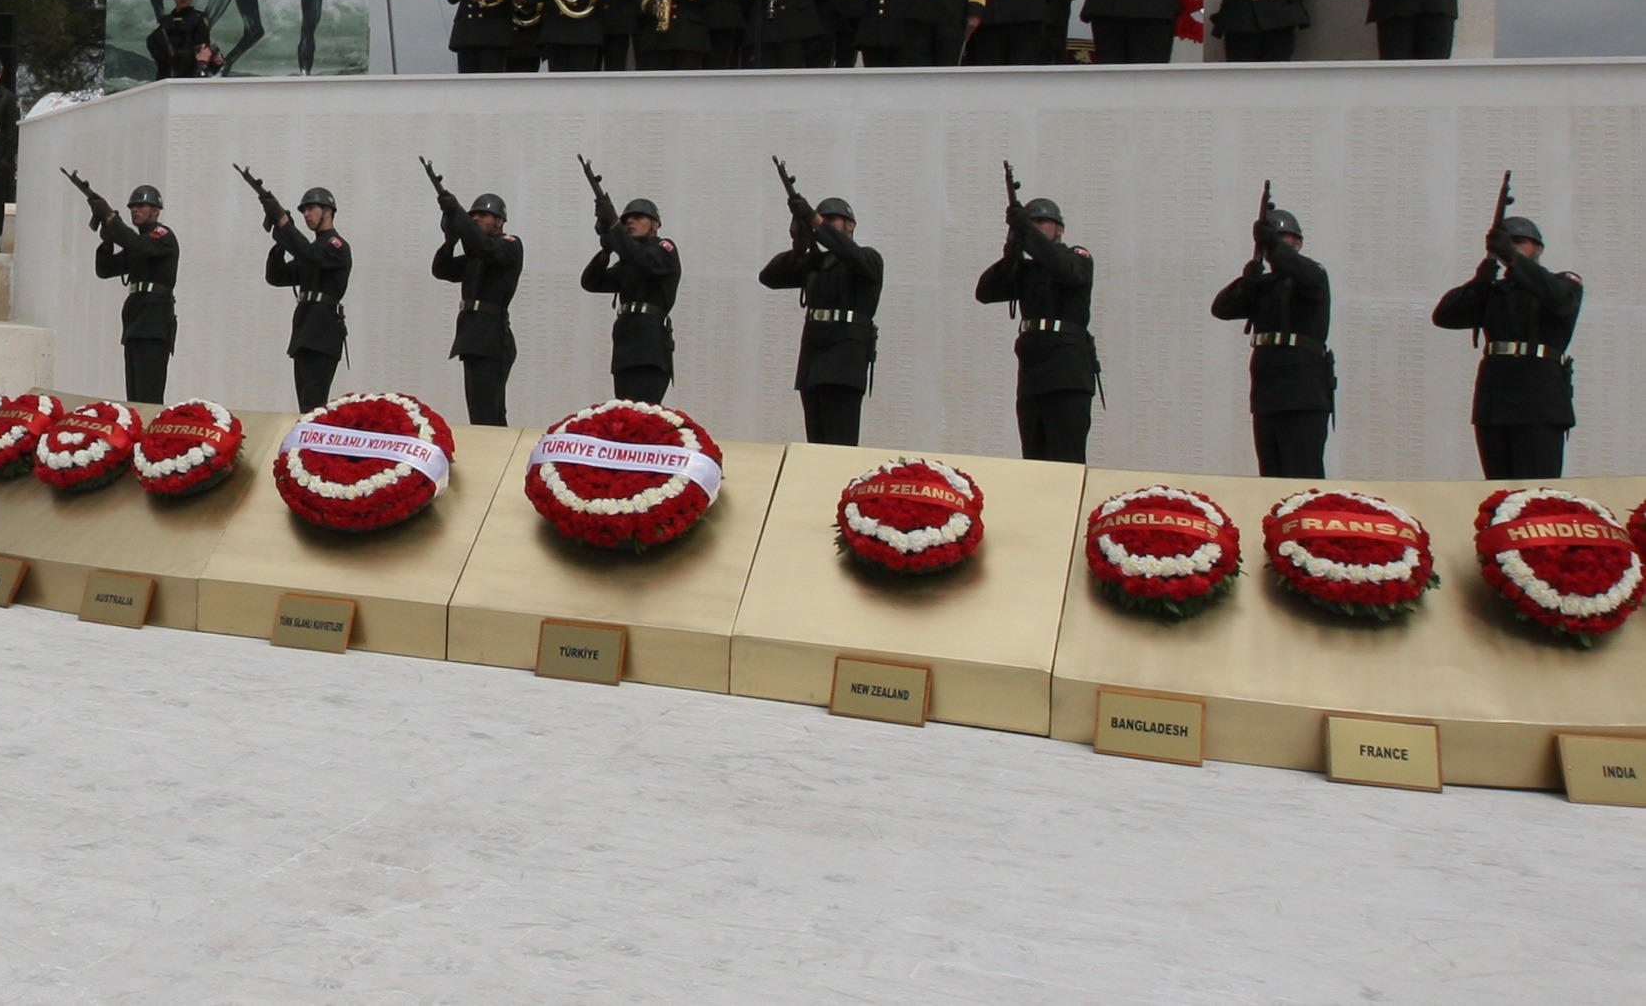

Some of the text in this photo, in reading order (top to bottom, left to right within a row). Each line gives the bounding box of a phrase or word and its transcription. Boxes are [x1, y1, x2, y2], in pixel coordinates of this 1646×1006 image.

[542, 437, 690, 468] TÜRKİYE CUMHURİYETİ
[890, 484, 966, 509] ZELANDA
[1282, 518, 1418, 543] FRANSA
[95, 593, 133, 606] AUSTRALIA
[560, 645, 599, 660] TÜRKİYE
[851, 682, 910, 701] NEW ZEALAND
[1111, 716, 1188, 737] BANGLADESH
[1359, 744, 1409, 761] FRANCE
[1602, 765, 1637, 780] INDIA
